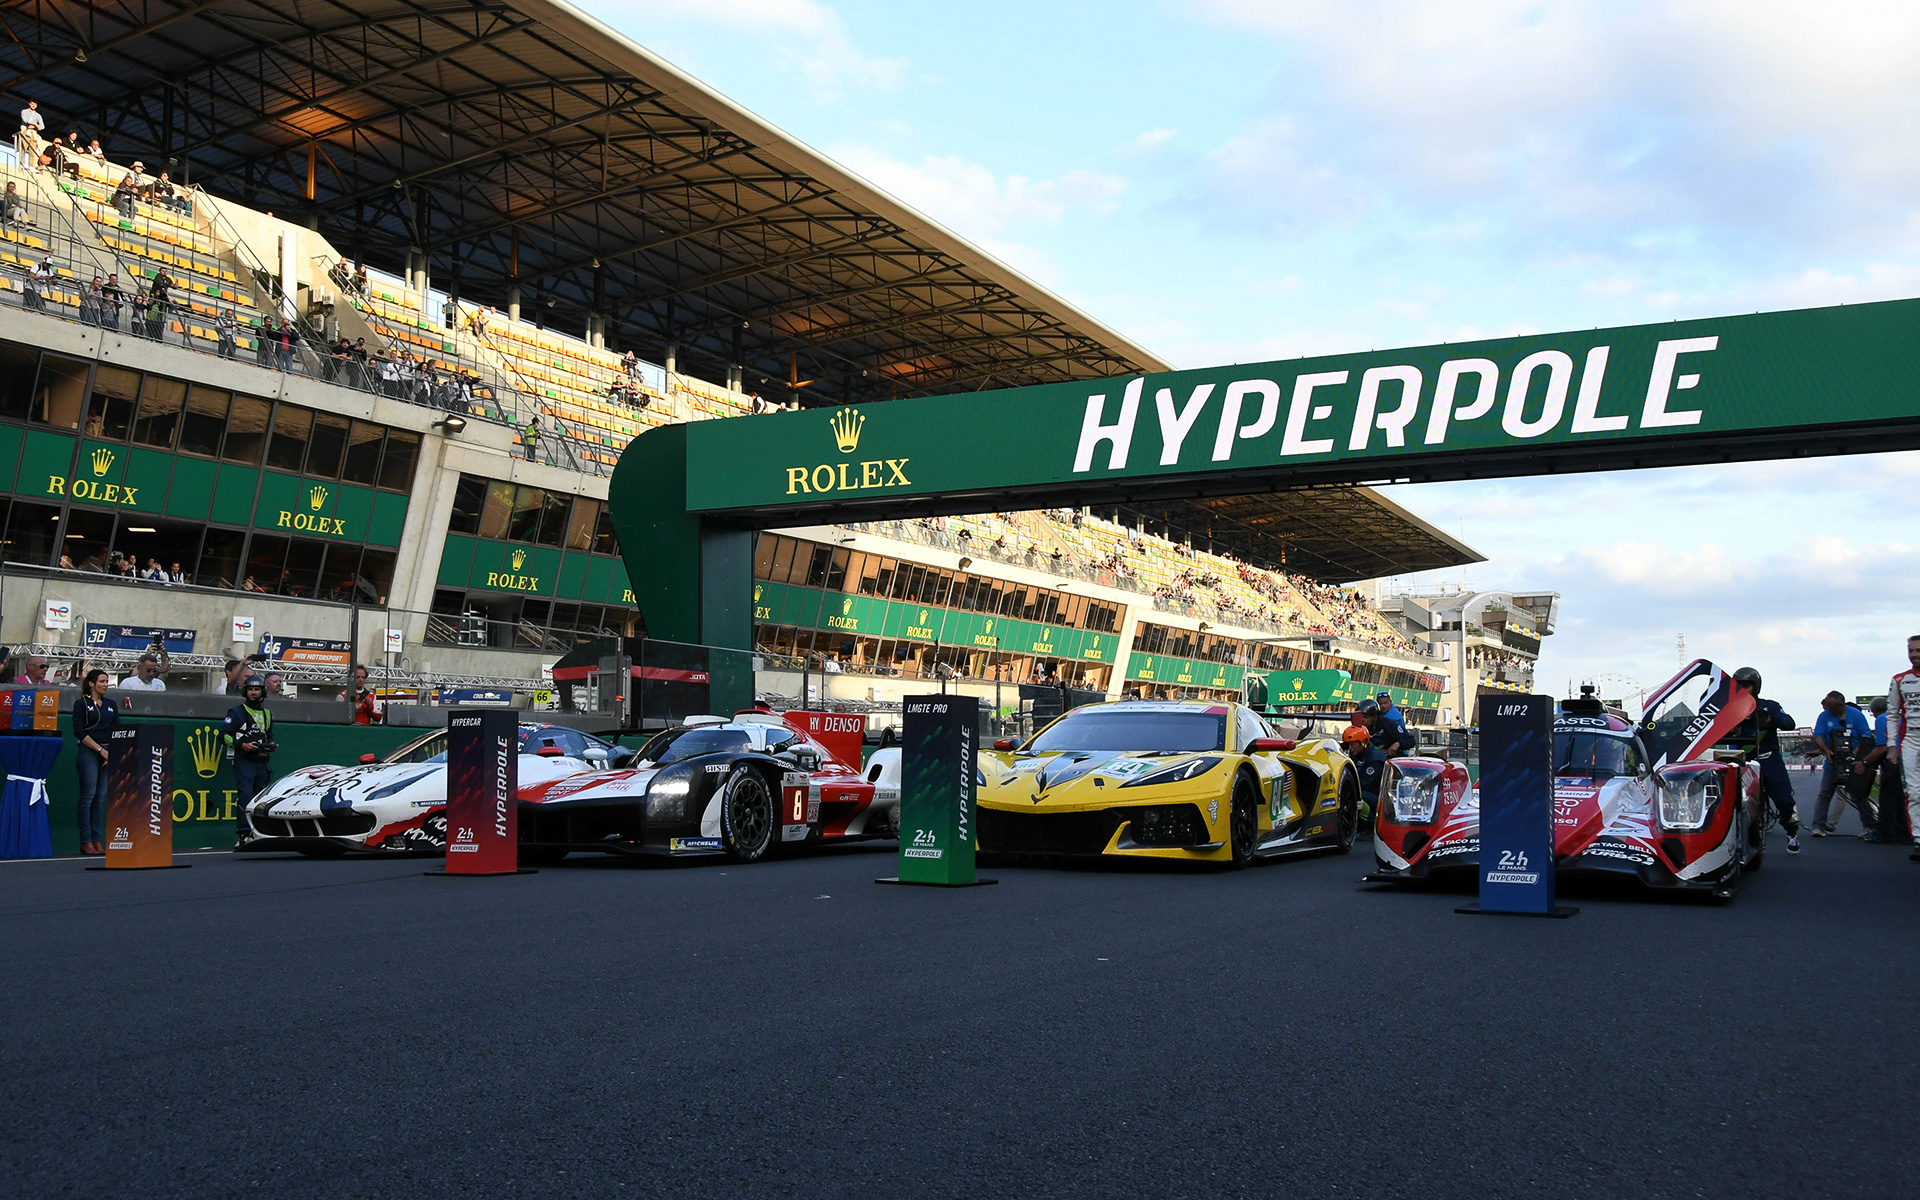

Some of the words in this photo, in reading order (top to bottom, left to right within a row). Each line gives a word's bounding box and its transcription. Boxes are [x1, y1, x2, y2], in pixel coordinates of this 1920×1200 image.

[1073, 336, 1719, 473] HYPERPOLE
[786, 458, 912, 495] ROLEX
[47, 475, 138, 506] ROLEX
[277, 510, 345, 536] ROLEX
[487, 572, 539, 591] ROLEX
[754, 607, 771, 619] EX
[828, 616, 858, 630] ROLEX
[88, 629, 107, 643] 38
[906, 626, 933, 639] ROLEX
[974, 634, 997, 647] ROLEX
[264, 642, 281, 654] 66
[1032, 642, 1053, 654] ROLEX
[1084, 648, 1102, 659] ROLEX
[307, 654, 343, 662] MOTORSPORT
[1138, 669, 1154, 679] ROLEX
[536, 692, 548, 702] 66
[1279, 692, 1318, 702] ROLEX
[907, 704, 930, 714] LMGTE
[932, 704, 948, 714] PRO
[1497, 705, 1528, 716] LMP2
[452, 718, 481, 727] HYPERCAR
[1693, 702, 1721, 730] BNI
[810, 716, 820, 731] HY
[824, 716, 861, 733] DENSO
[112, 730, 126, 738] LMGTE
[128, 730, 136, 738] AM
[1106, 761, 1144, 774] 64
[495, 736, 508, 837] HYPERPOLE
[958, 724, 970, 841] HYPERPOLE
[149, 746, 162, 836] HYPERPOLE
[793, 790, 802, 820] 8
[906, 850, 940, 858] HYPERPOLE
[1428, 846, 1480, 860] TURBO
[1582, 850, 1643, 863] TURBO
[1628, 845, 1652, 855] BELL
[1490, 874, 1534, 883] HYPERPOLE
